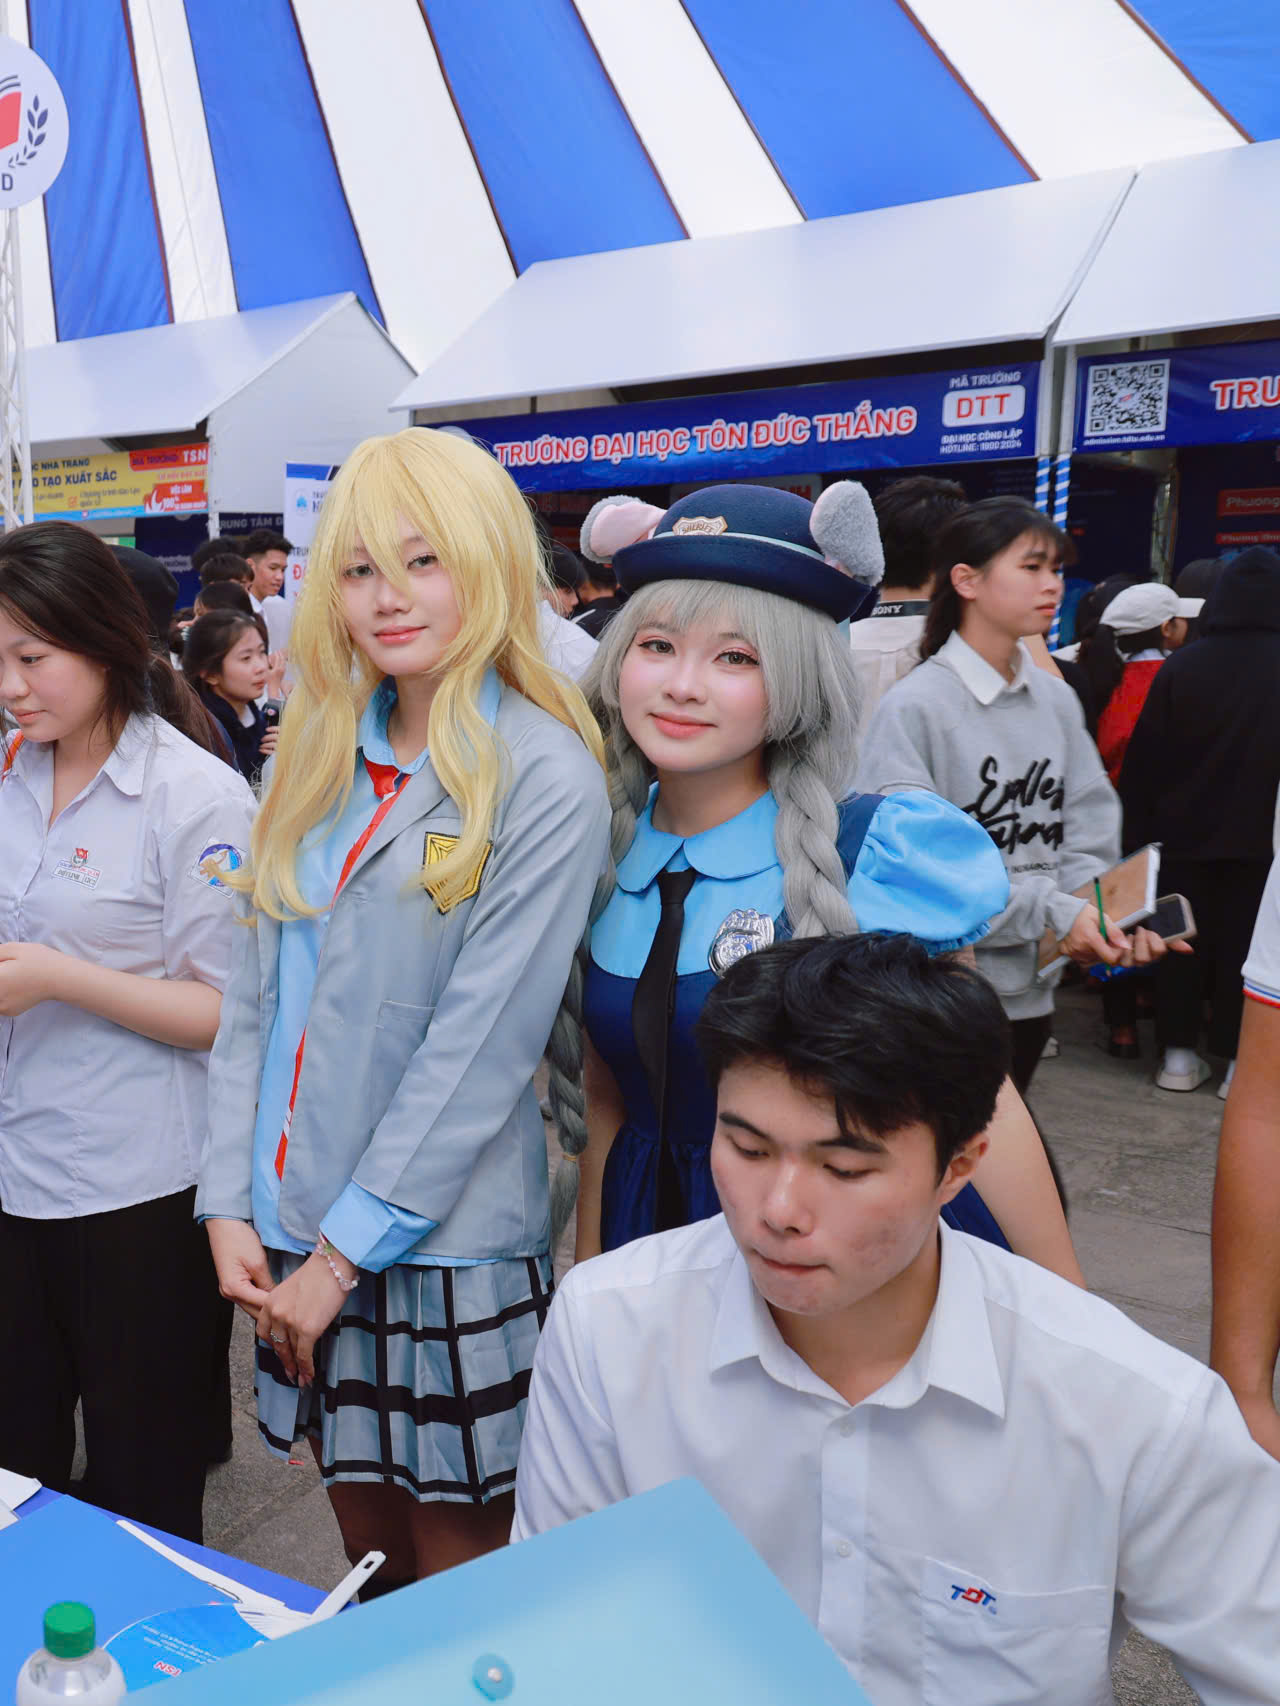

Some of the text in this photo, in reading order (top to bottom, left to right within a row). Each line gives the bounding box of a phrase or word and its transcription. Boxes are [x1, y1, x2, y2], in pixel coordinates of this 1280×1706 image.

[949, 371, 1021, 388] MÃ TRƯỜNG
[956, 393, 1011, 418] DTT
[495, 401, 917, 466] TRƯỜNG ĐẠI HỌC TÔN ĐỨC THẮNG
[959, 432, 976, 444] HỌC
[978, 430, 1002, 441] CÔNG
[183, 448, 207, 464] TSN
[940, 442, 979, 454] HOTLINE:
[41, 461, 59, 471] NHA
[62, 458, 90, 468] TRANG
[43, 476, 62, 489] TẠO
[65, 470, 92, 484] XUẤT
[95, 466, 117, 482] SẮC
[872, 605, 903, 617] SONY
